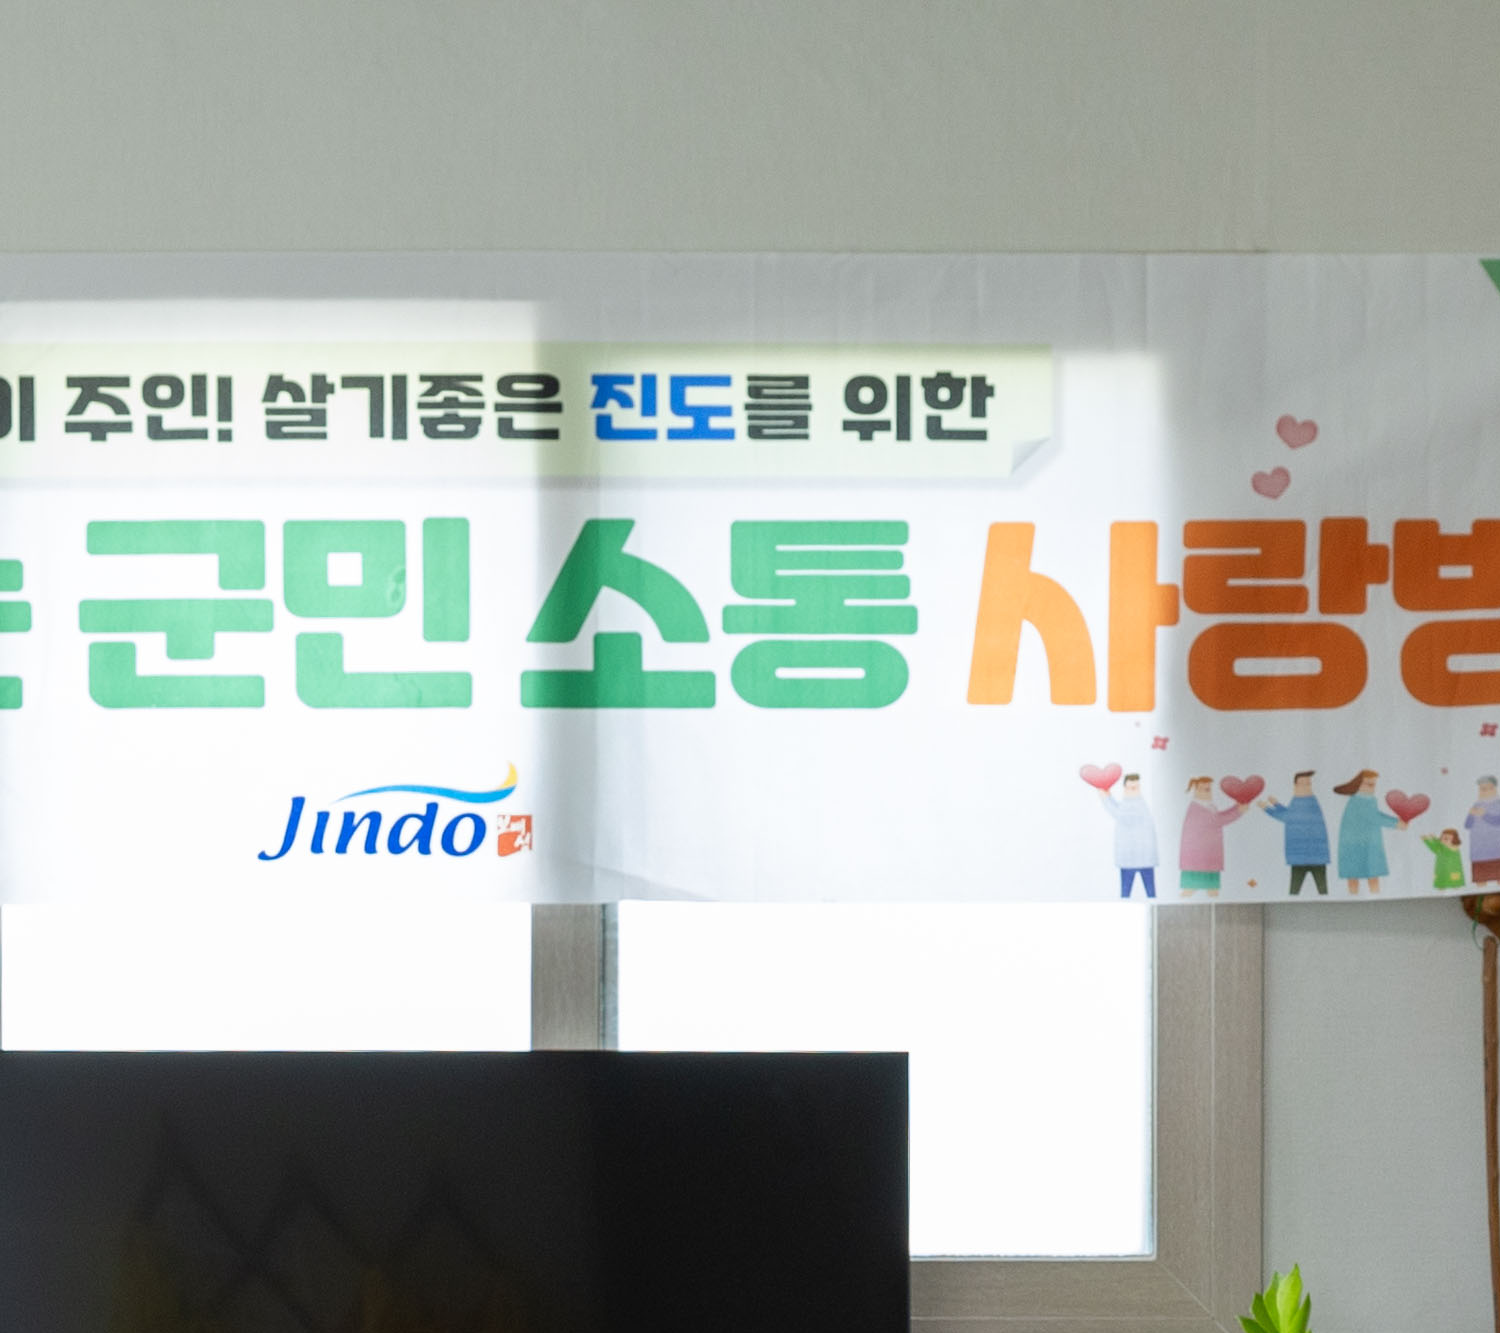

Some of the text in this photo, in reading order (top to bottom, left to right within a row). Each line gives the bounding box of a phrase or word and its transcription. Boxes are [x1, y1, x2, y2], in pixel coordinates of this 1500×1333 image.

[62, 373, 237, 444] 주인!
[259, 371, 562, 444] 살기좋은
[586, 371, 814, 442] 진도를
[840, 368, 996, 442] 위한
[78, 516, 474, 712] 군민
[519, 516, 919, 712] 소통
[257, 794, 488, 862] Jindo
